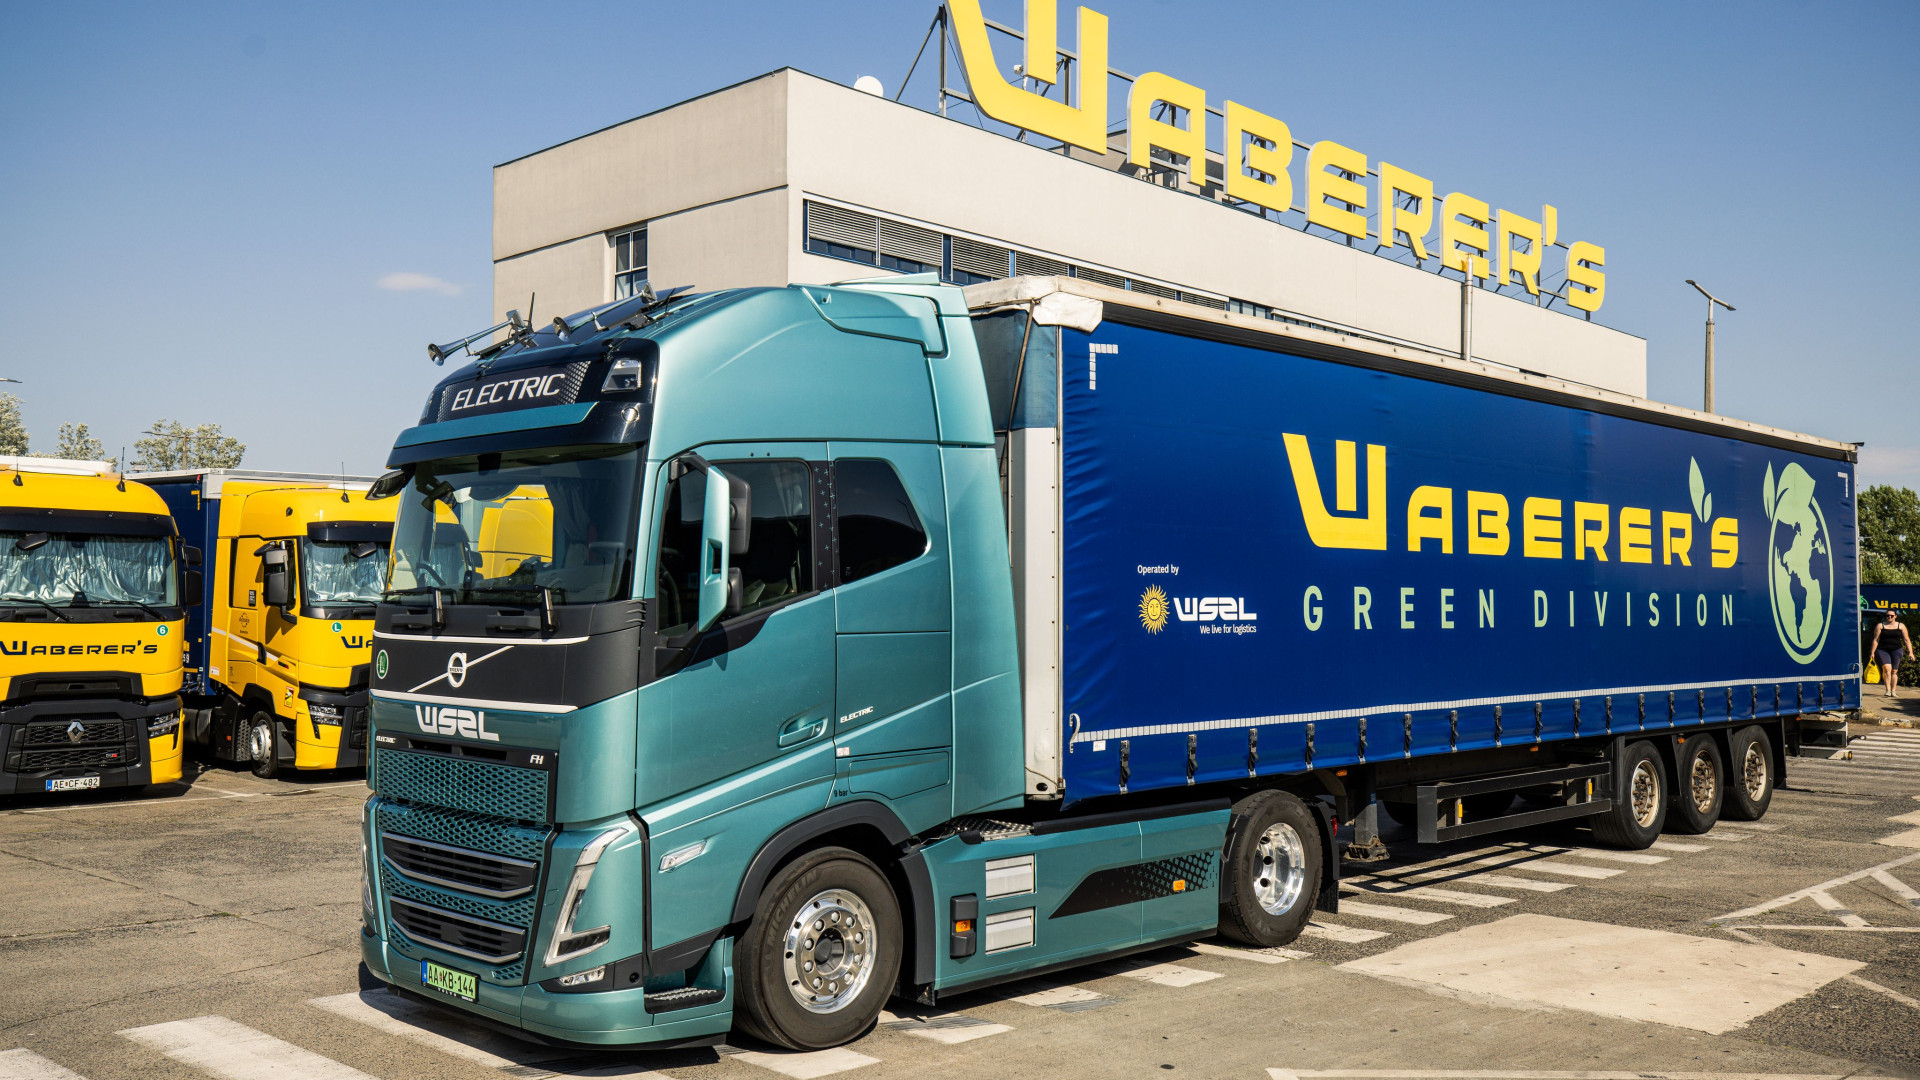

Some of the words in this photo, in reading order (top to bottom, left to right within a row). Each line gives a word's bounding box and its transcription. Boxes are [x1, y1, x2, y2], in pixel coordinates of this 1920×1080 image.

[451, 373, 566, 412] ELECTRIC
[1137, 564, 1169, 576] Operated
[1170, 564, 1179, 576] by
[1303, 585, 1495, 632] GREEN
[1534, 589, 1733, 628] DIVISION
[159, 625, 166, 635] 6
[1200, 625, 1211, 635] We
[1211, 624, 1222, 634] live
[1223, 624, 1232, 634] for
[1232, 624, 1257, 636] logistics
[840, 706, 874, 724] ELECTRIC
[529, 754, 545, 765] FH
[839, 789, 849, 797] bar
